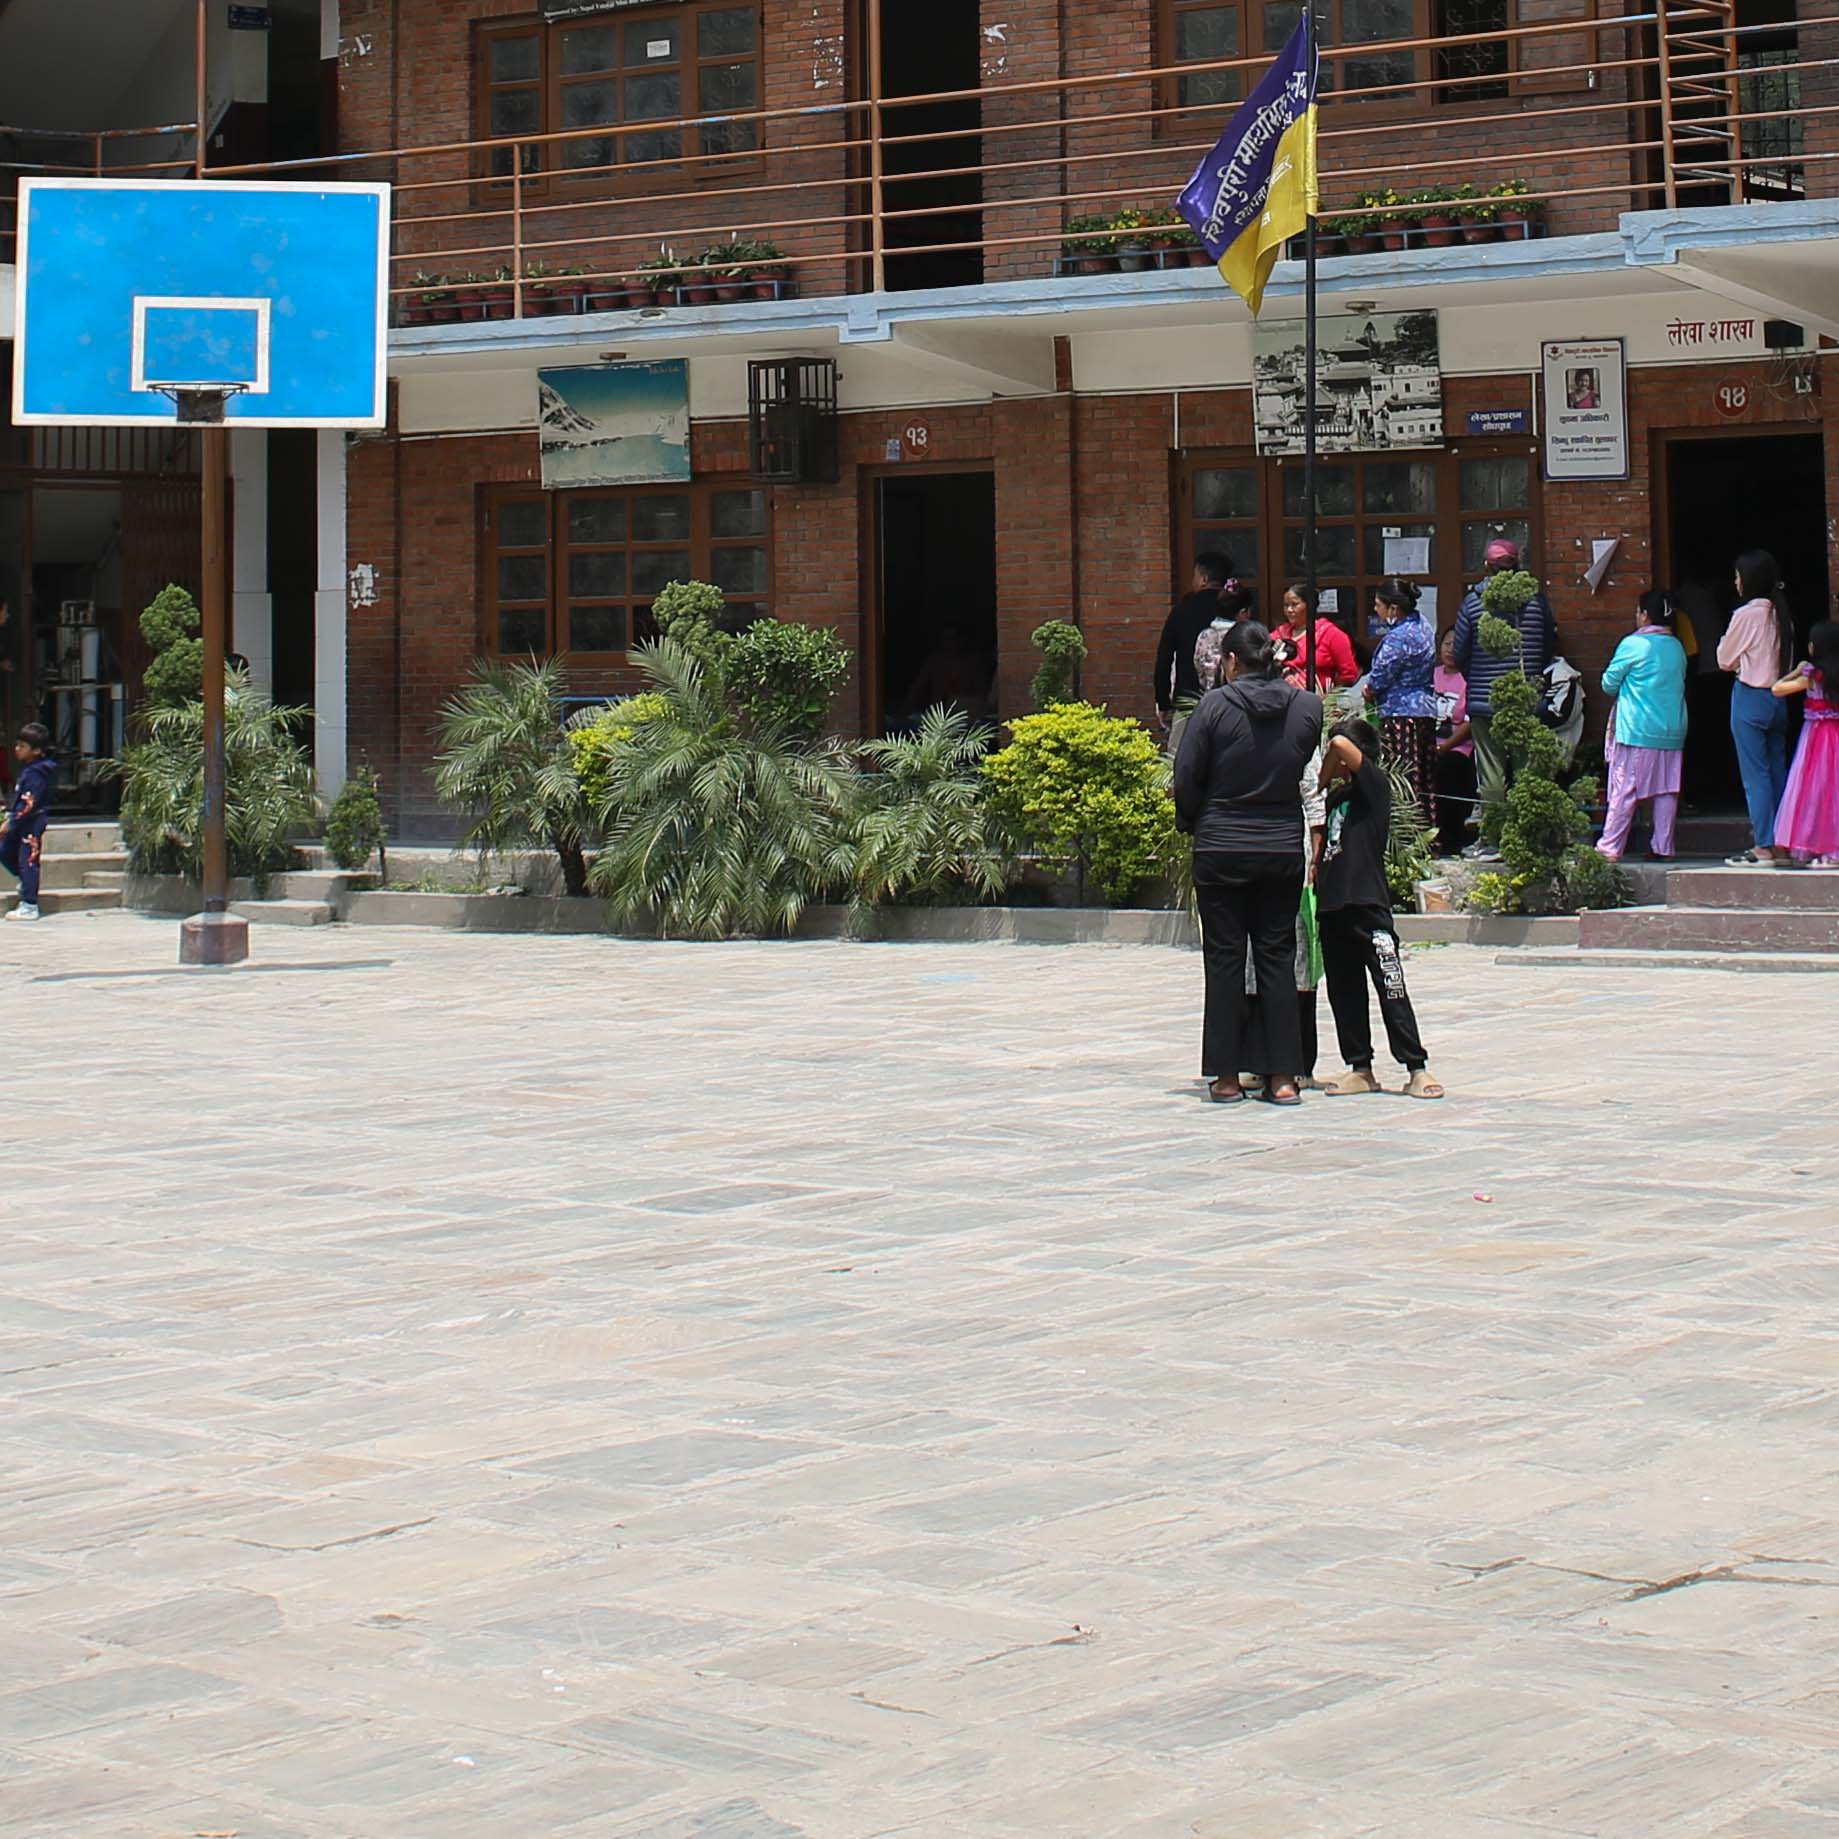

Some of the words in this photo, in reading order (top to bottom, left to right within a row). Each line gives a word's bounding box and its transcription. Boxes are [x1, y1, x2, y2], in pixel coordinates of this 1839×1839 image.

[1201, 159, 1249, 244] शिवपुरी
[1666, 318, 1705, 346] लेखा
[1709, 320, 1754, 343] शाखा
[1720, 387, 1746, 408] १४
[906, 427, 927, 446] १३
